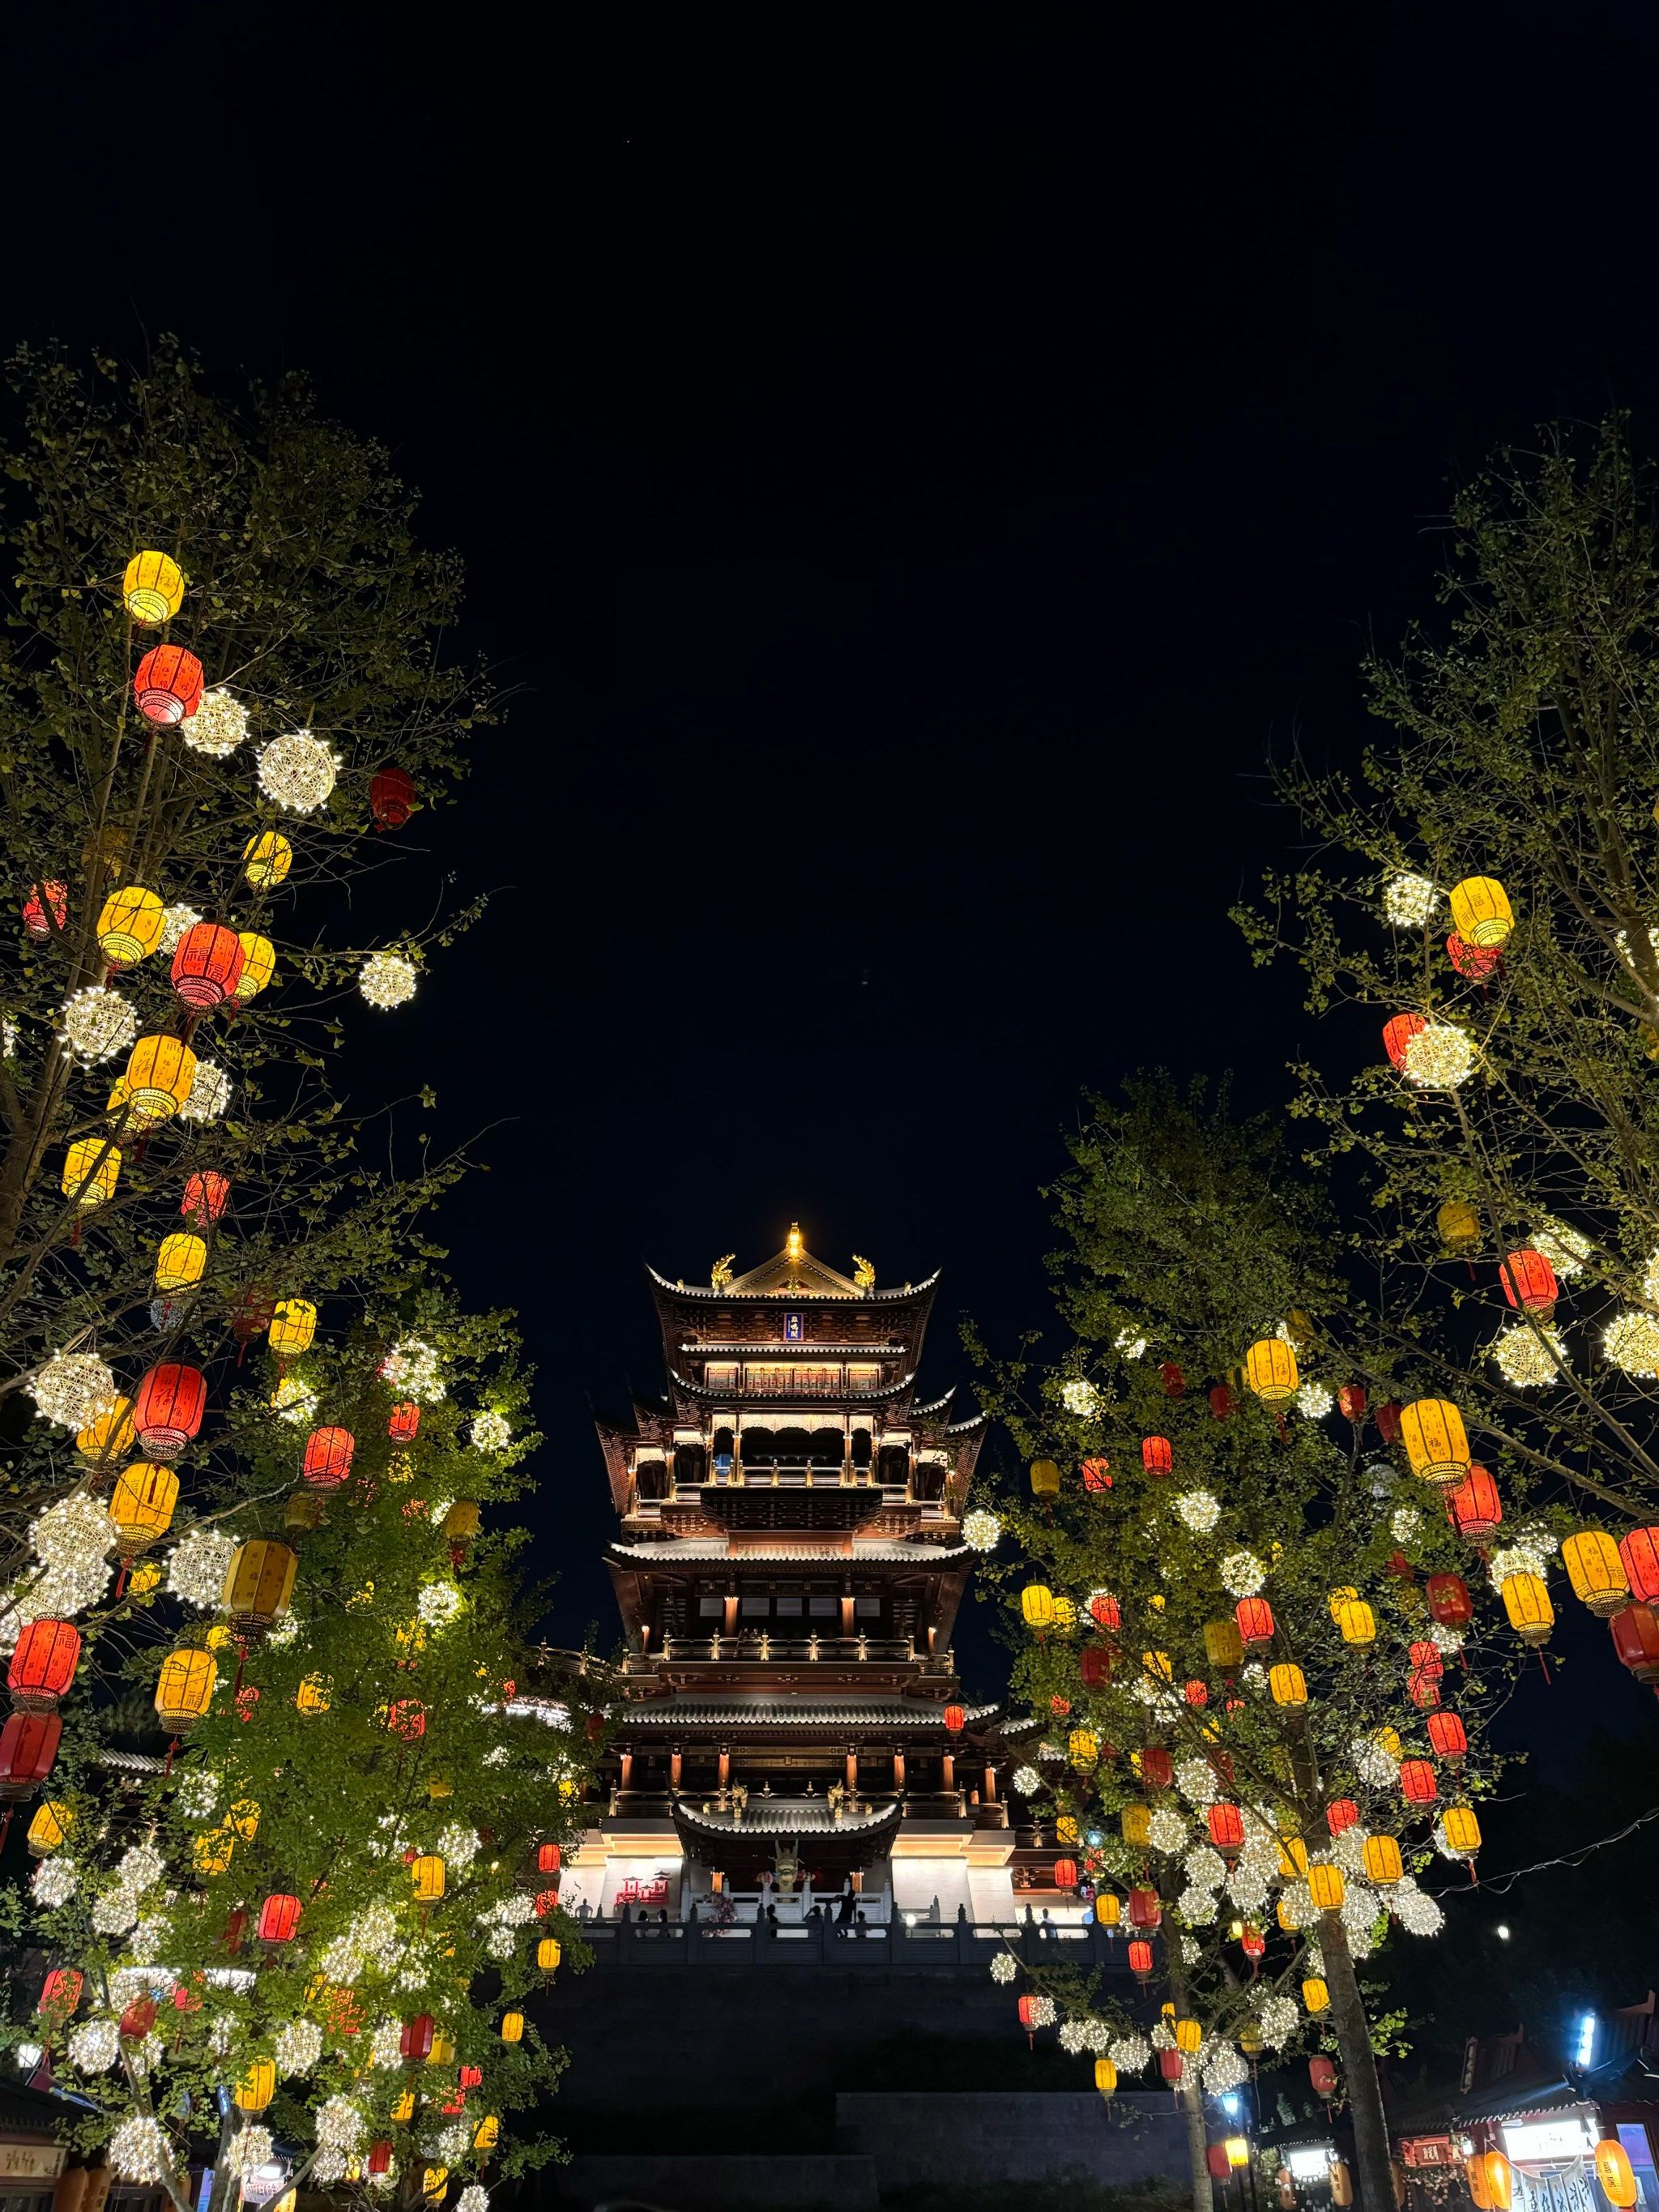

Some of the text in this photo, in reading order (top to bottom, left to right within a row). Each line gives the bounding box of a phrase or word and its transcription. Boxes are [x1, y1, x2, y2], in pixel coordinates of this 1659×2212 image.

[186, 946, 211, 962] 福
[207, 960, 225, 982] 福
[1607, 1565, 1627, 1582] 福
[56, 1629, 76, 1650] 福
